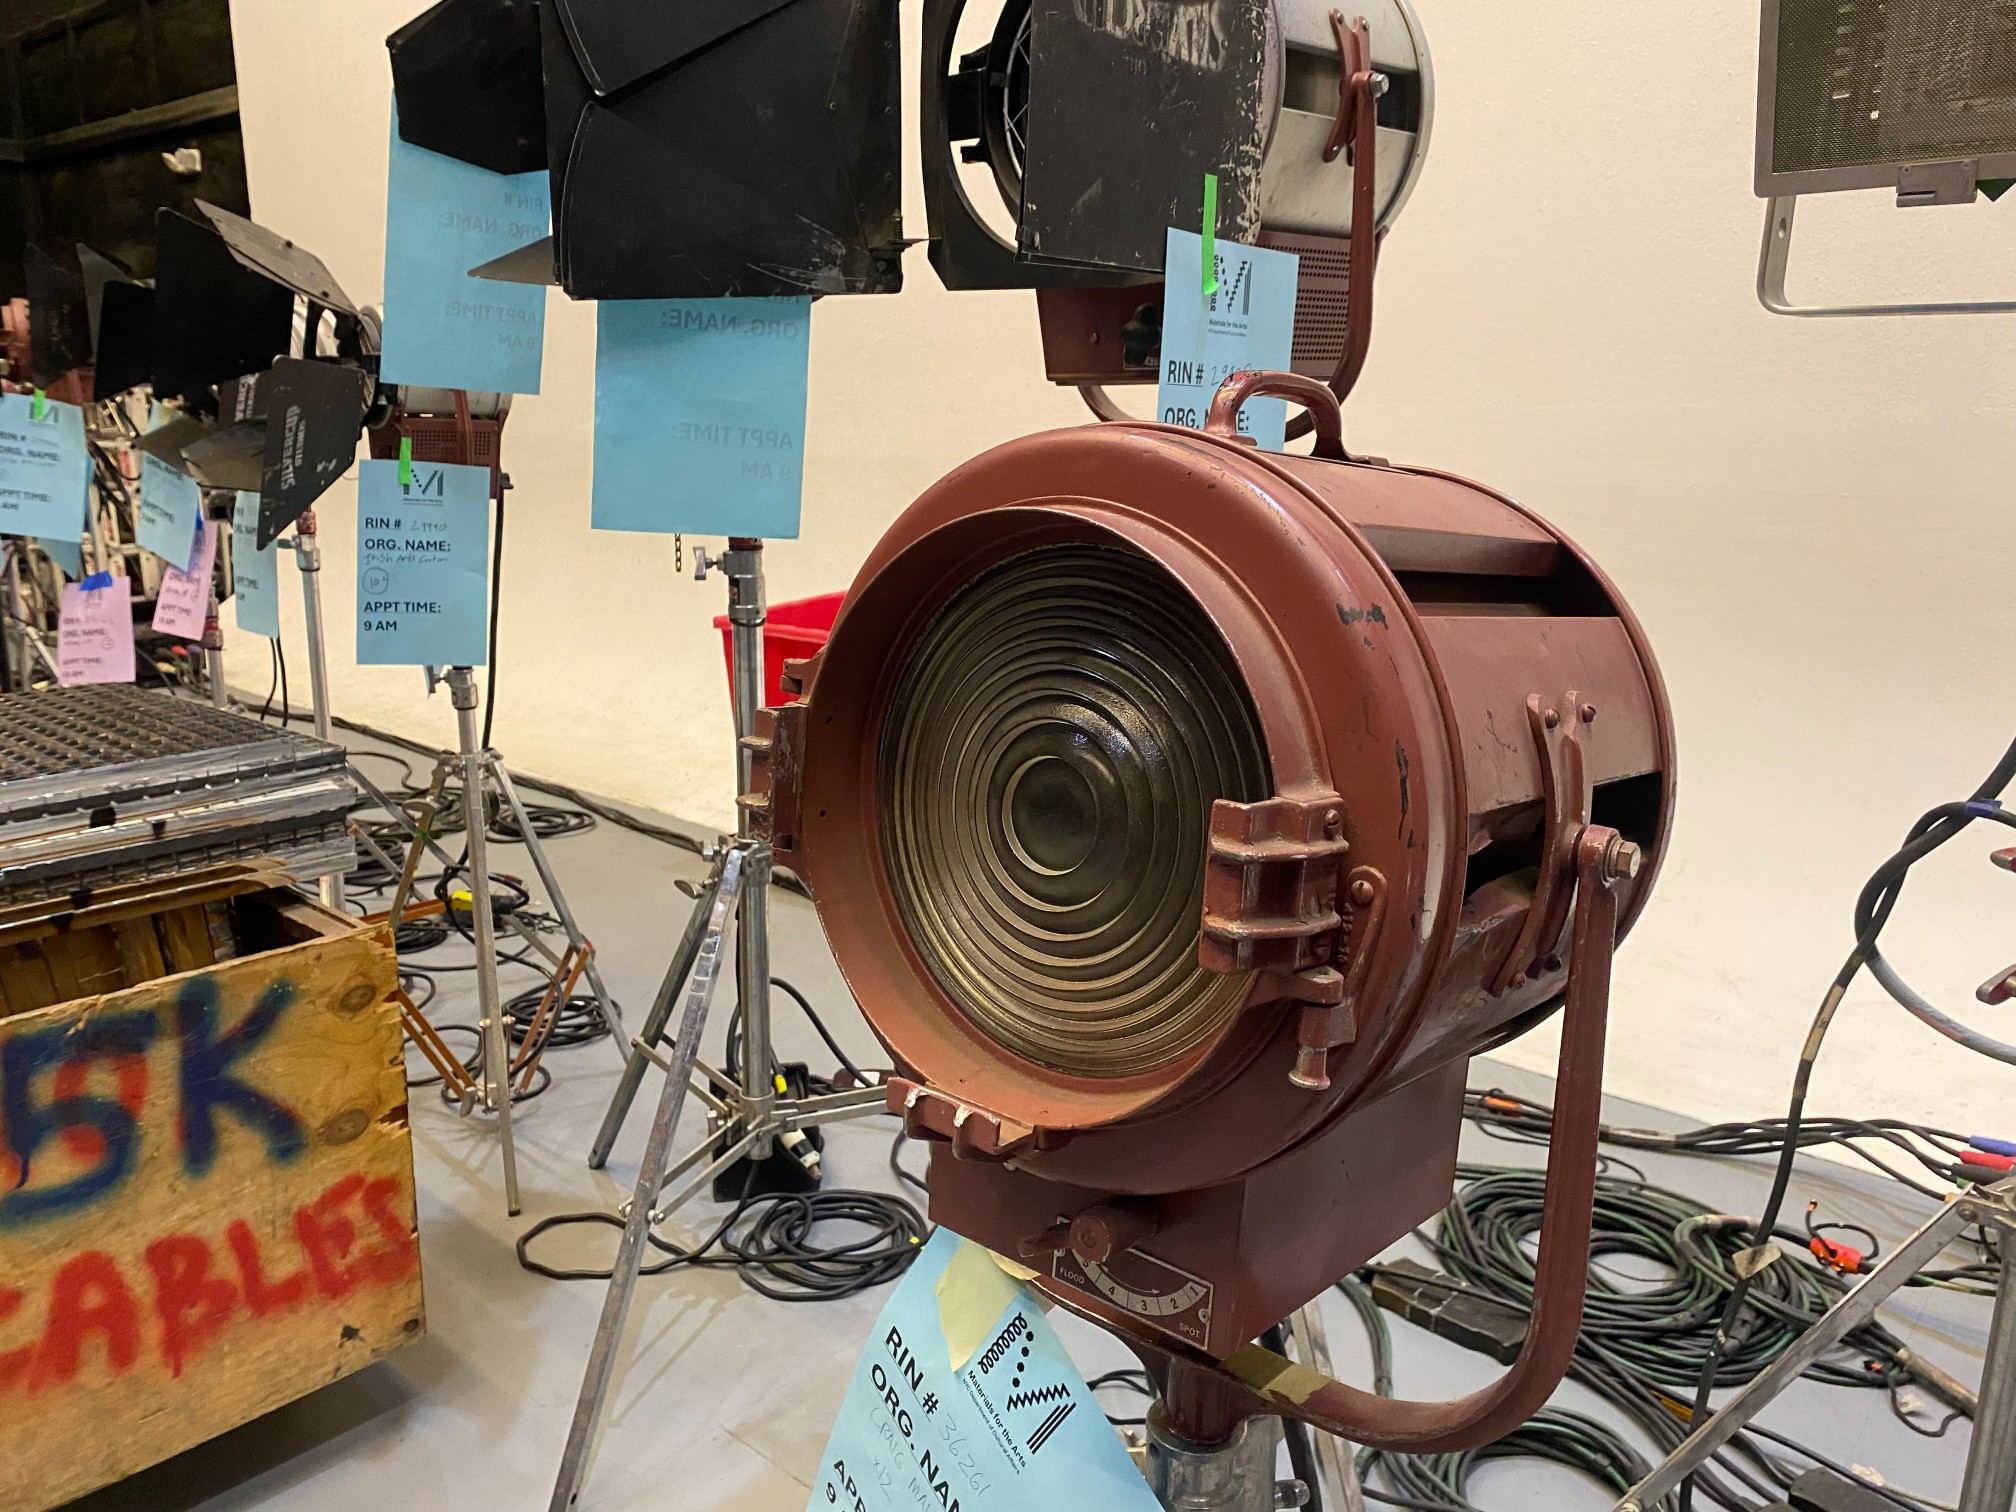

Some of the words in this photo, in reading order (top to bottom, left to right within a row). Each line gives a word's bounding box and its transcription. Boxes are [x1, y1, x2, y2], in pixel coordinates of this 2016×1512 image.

[1167, 360, 1193, 384] RIN
[1195, 363, 1204, 384] #
[281, 405, 301, 490] SILVERCUP
[365, 517, 390, 528] RIN
[365, 538, 401, 550] ORG.
[405, 539, 451, 552] NAME:
[363, 602, 400, 614] APPT
[403, 602, 442, 614] TIME:
[363, 620, 371, 631] 9
[375, 621, 397, 631] AM
[1059, 1266, 1086, 1285] FLOOD
[1107, 1285, 1116, 1296] 4
[1189, 1285, 1200, 1297] 1
[1140, 1299, 1148, 1312] 3
[1169, 1298, 1179, 1310] 2
[1179, 1322, 1201, 1338] SPOT
[885, 1326, 924, 1393] RIN
[922, 1392, 940, 1415] #
[871, 1363, 915, 1451] ORG.
[968, 1370, 995, 1415] Materials
[993, 1413, 1004, 1428] for
[1002, 1429, 1013, 1446] the
[1011, 1445, 1026, 1467] Arts
[869, 1407, 904, 1469] CRAIG
[938, 1413, 992, 1497] 36261
[825, 1481, 836, 1504] 9
